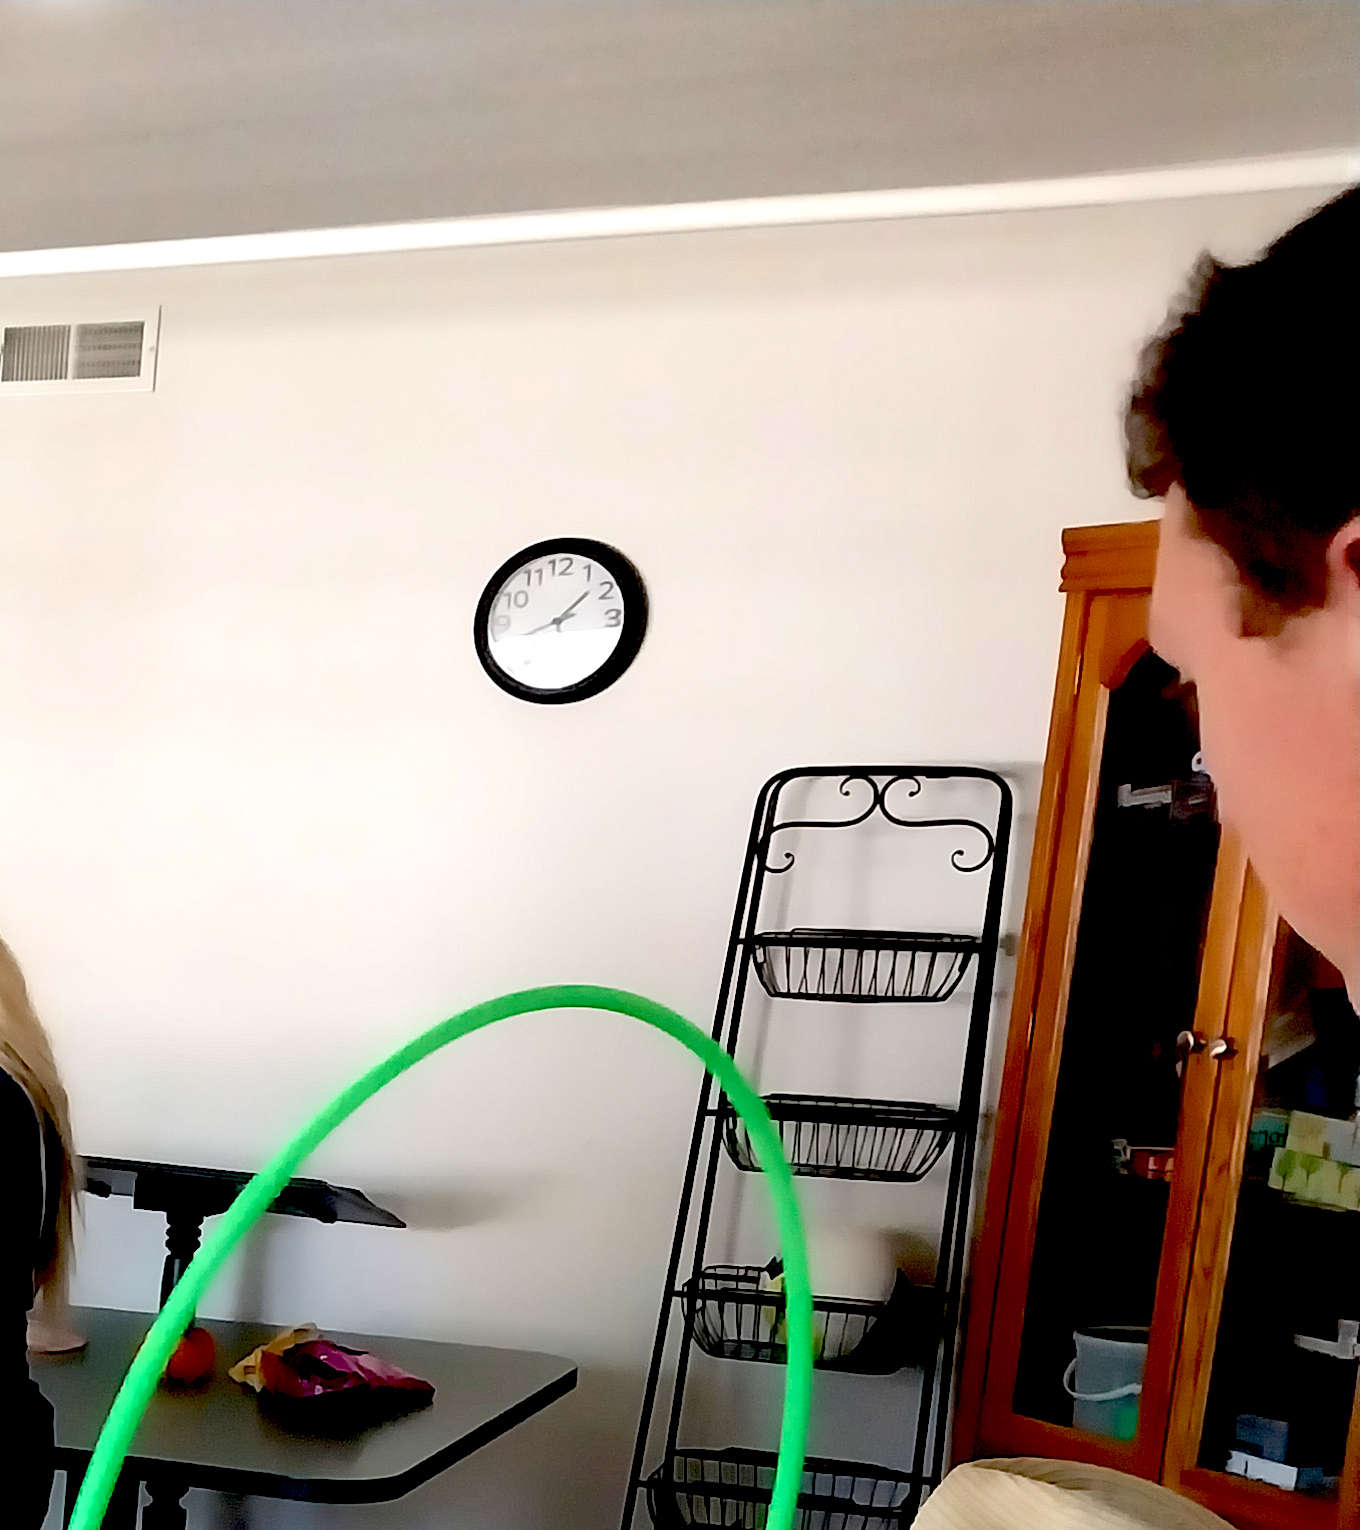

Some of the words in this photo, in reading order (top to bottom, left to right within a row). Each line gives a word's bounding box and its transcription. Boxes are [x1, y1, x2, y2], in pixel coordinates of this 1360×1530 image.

[547, 557, 574, 577] 12
[583, 564, 592, 583] 1
[523, 568, 543, 586] 11
[504, 590, 529, 609] 10
[598, 581, 614, 600] 2
[604, 608, 622, 627] 3
